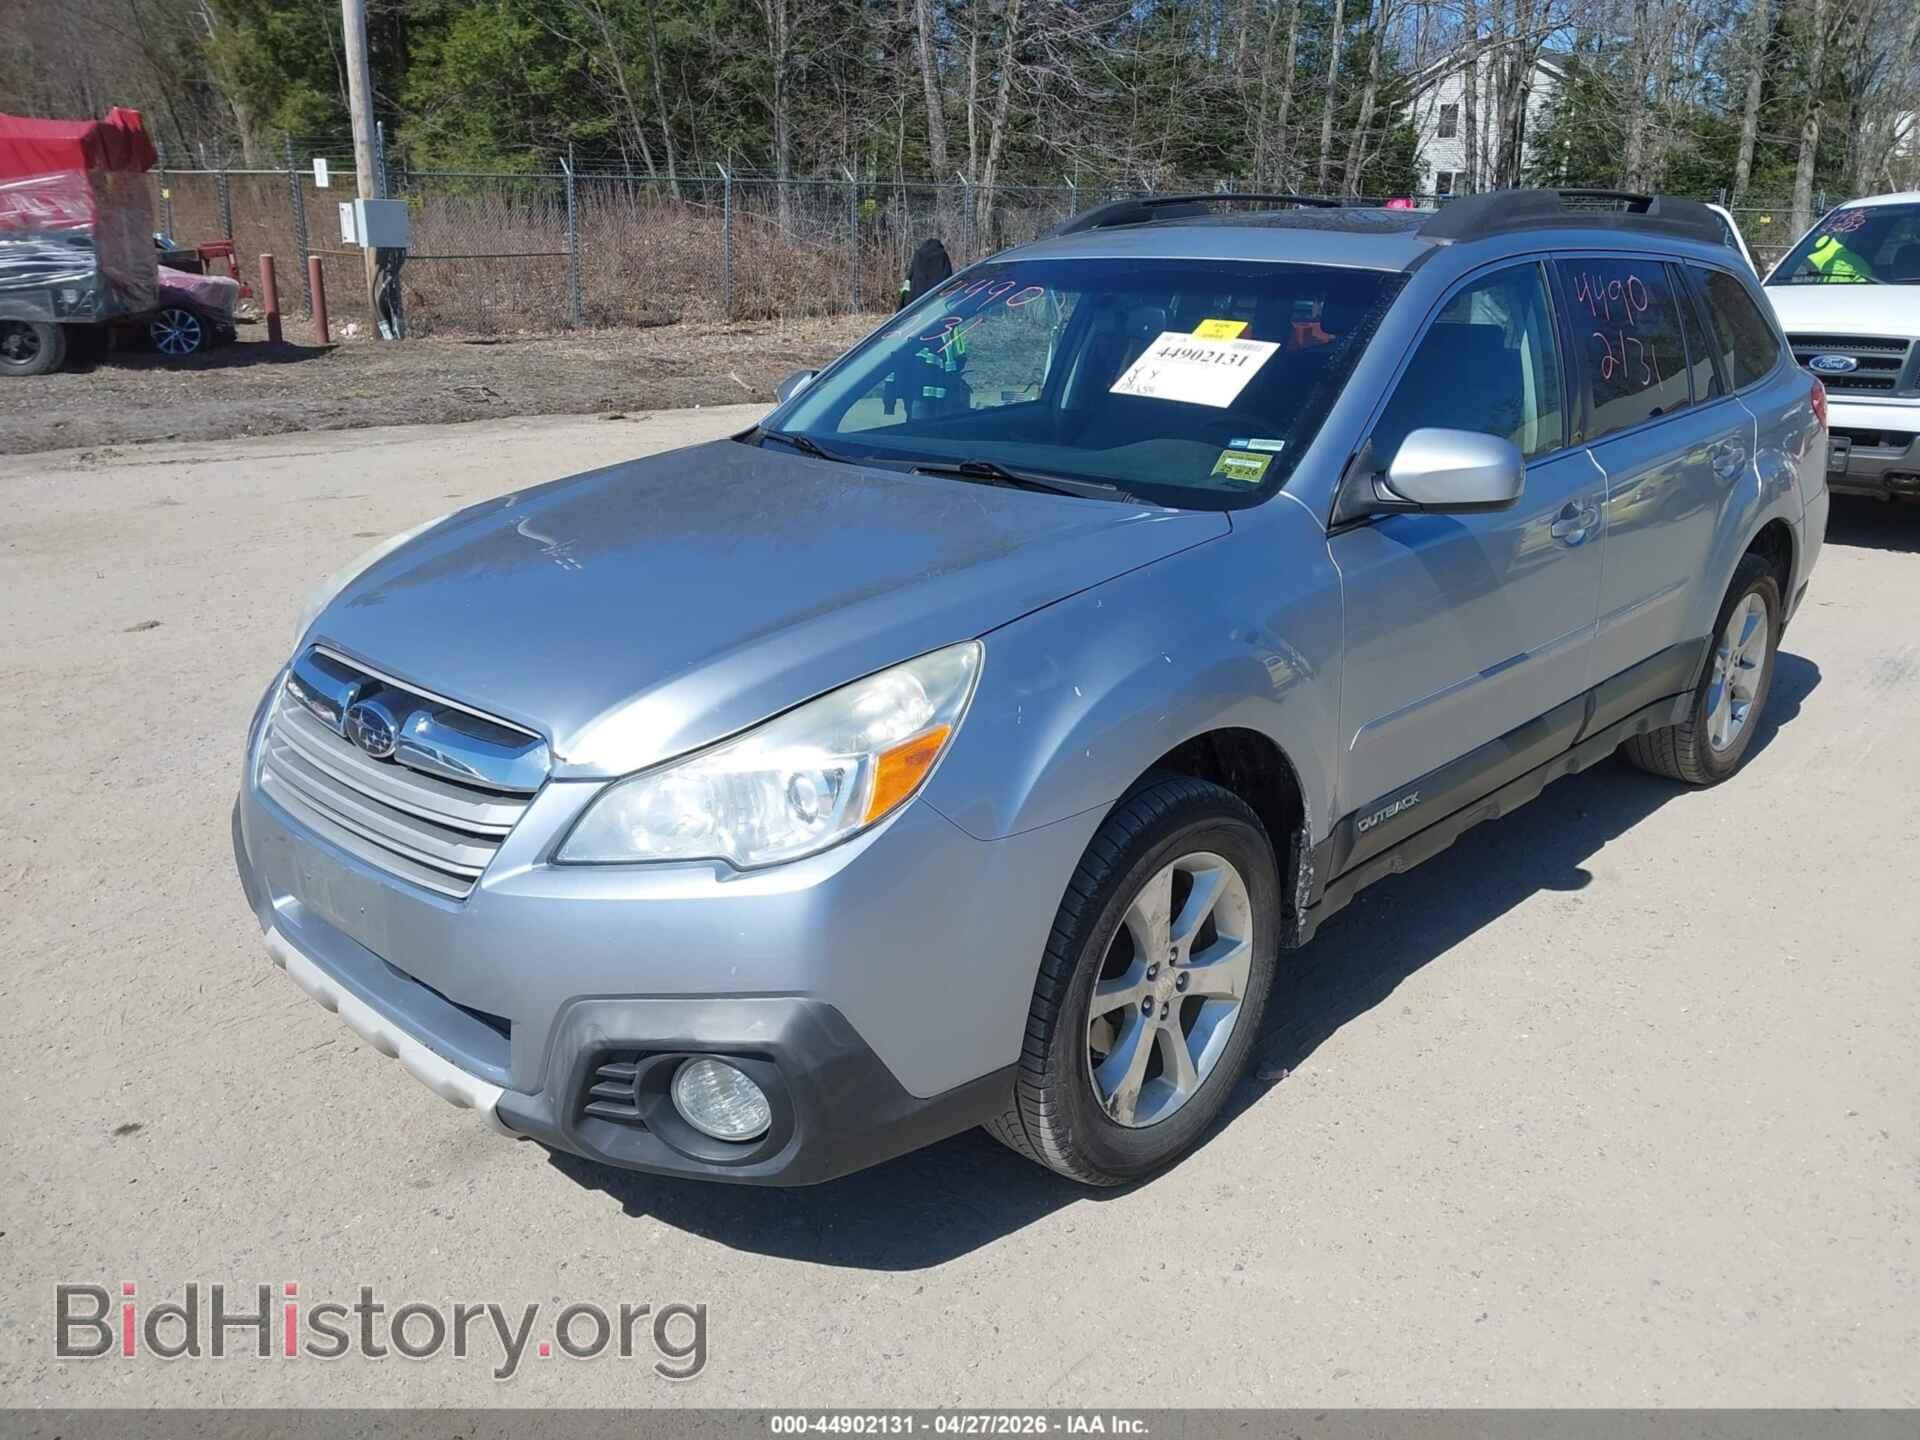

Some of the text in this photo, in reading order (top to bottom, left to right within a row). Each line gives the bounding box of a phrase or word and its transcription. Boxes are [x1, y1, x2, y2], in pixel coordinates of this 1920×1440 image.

[1574, 272, 1648, 326] 4490
[1157, 347, 1249, 367] 44902131
[1593, 329, 1664, 393] 2131
[1358, 791, 1421, 832] OUTBACK
